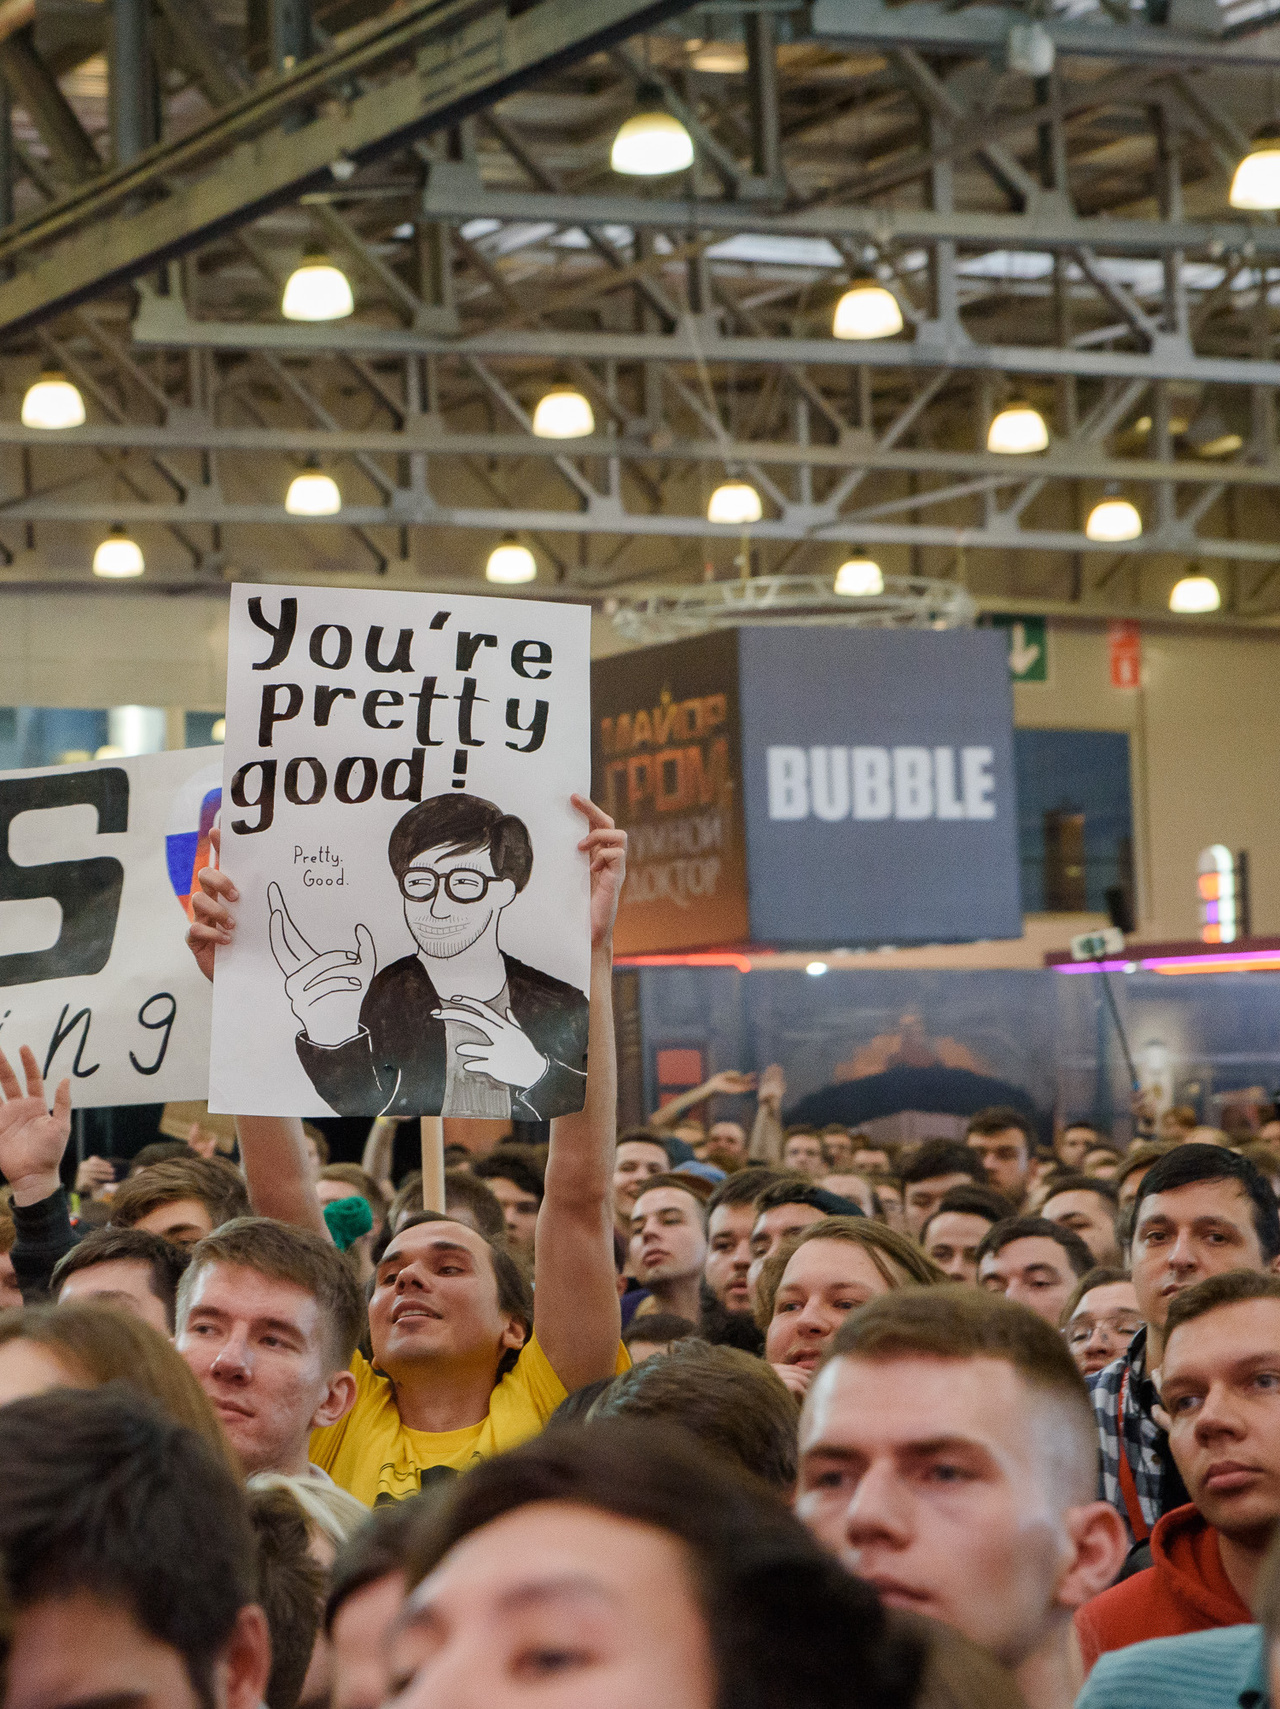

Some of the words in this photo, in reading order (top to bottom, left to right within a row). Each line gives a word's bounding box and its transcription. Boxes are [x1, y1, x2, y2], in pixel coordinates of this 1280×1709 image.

[247, 596, 553, 680] You're
[258, 676, 550, 753] pretty
[230, 747, 469, 835] good!
[604, 739, 729, 818] ГРОМ
[765, 745, 997, 820] BUBBLE
[293, 845, 343, 867] Pretty.
[303, 867, 349, 887] Good.
